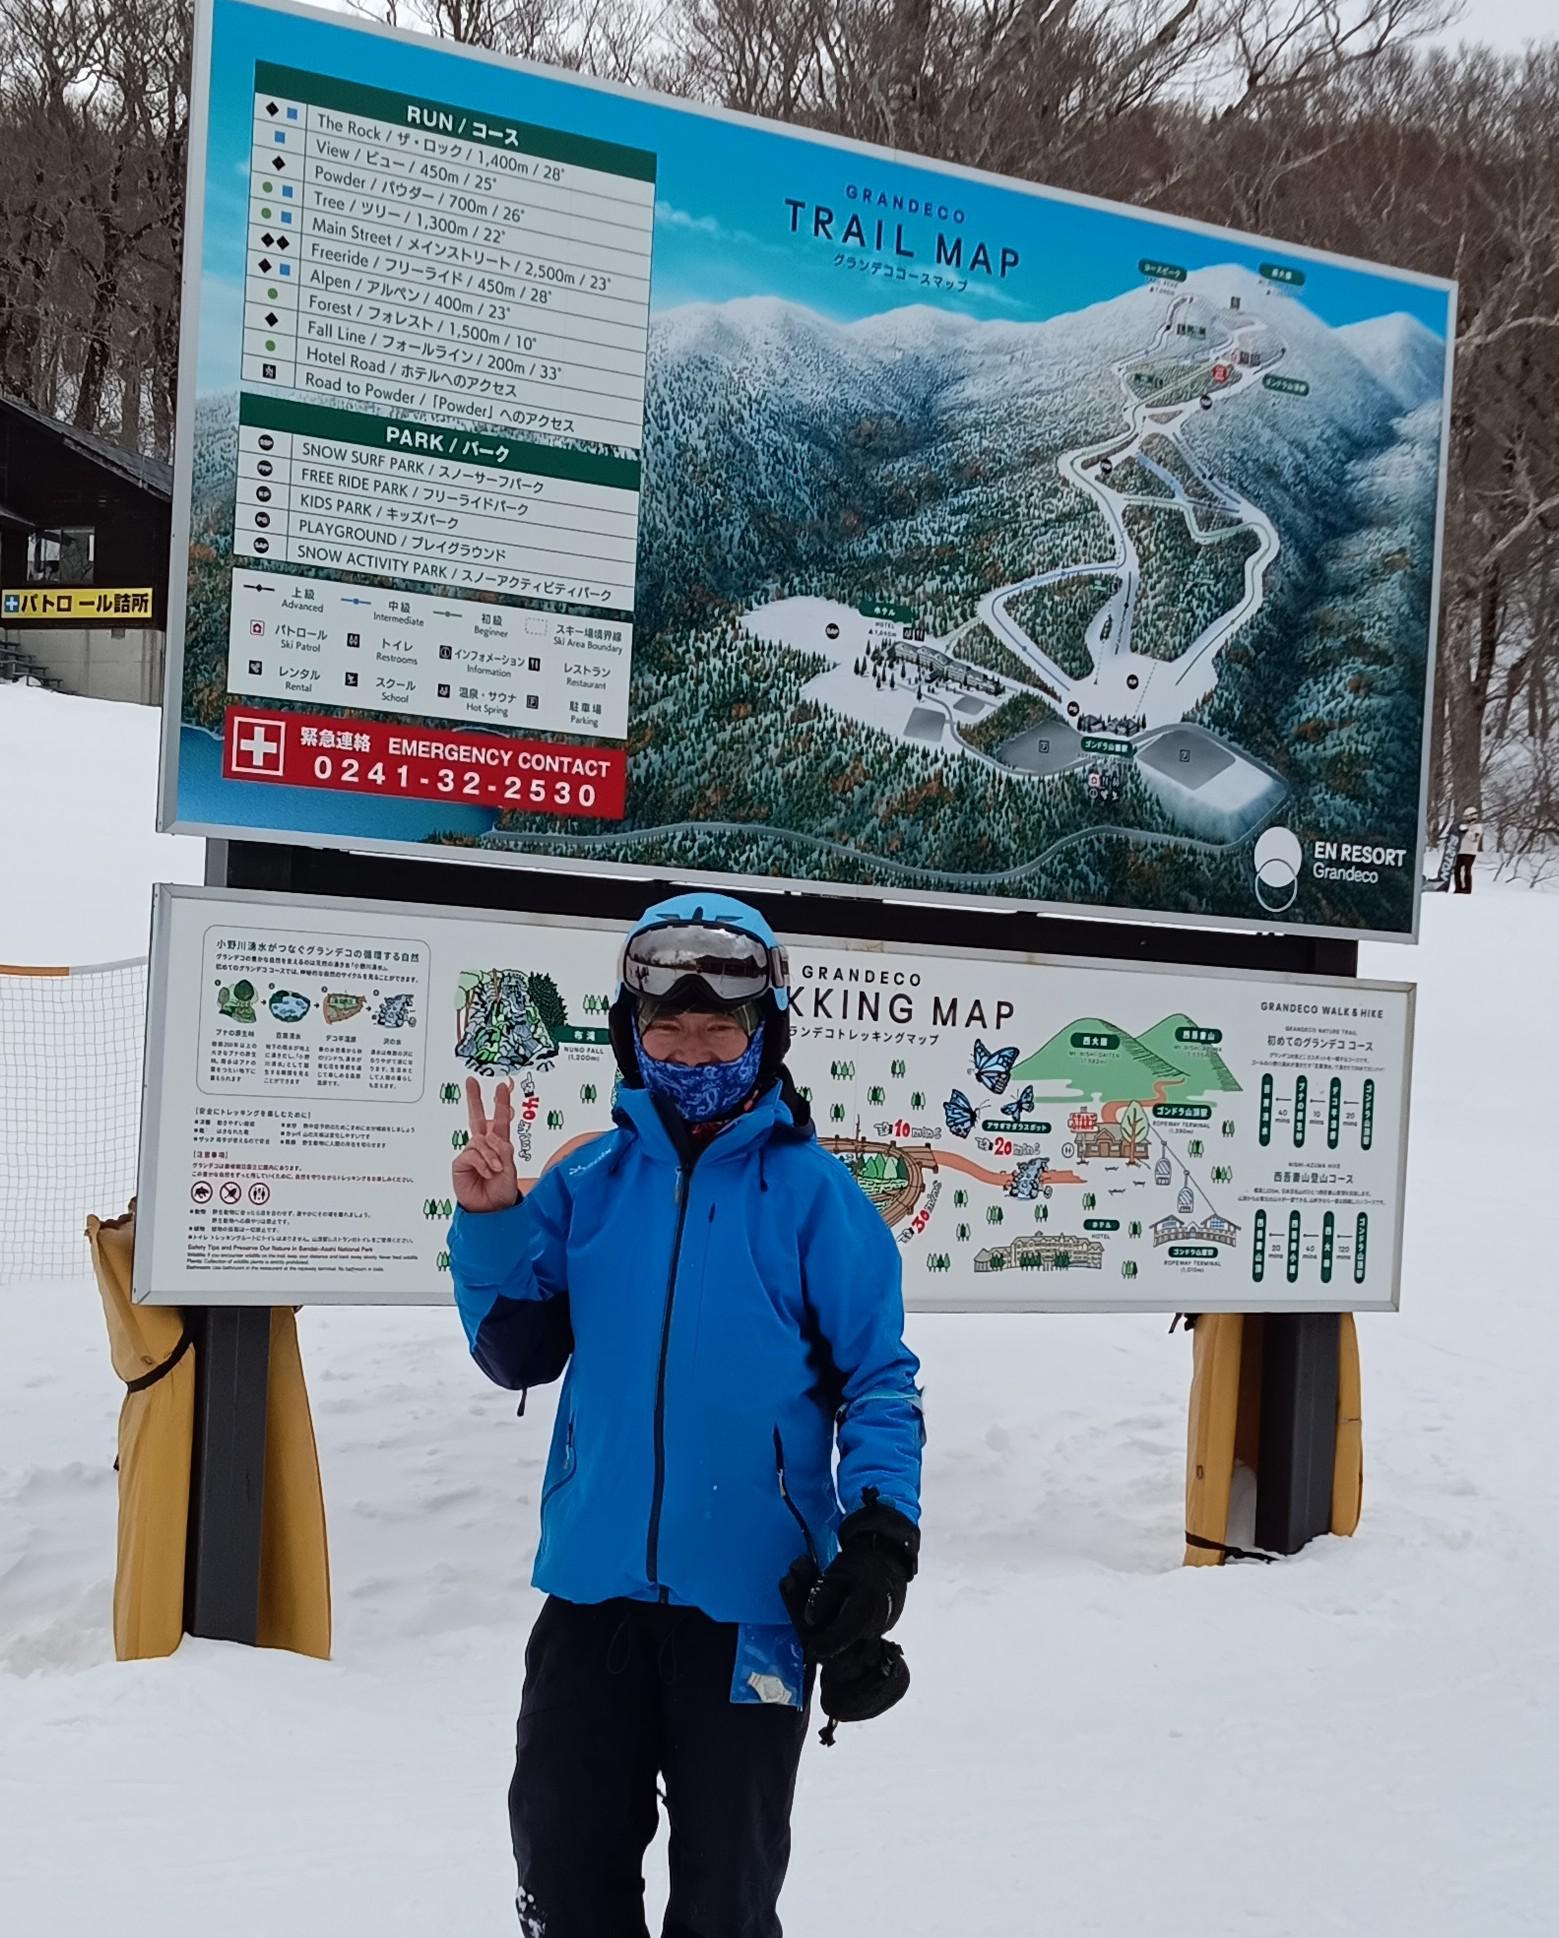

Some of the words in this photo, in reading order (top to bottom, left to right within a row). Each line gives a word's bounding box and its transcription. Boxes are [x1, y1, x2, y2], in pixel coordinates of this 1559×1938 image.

[408, 105, 453, 131] RUN
[316, 113, 344, 132] The
[347, 119, 382, 141] Rock
[479, 150, 529, 175] 1,400m
[316, 139, 350, 160] View
[420, 164, 458, 183] 450m
[314, 165, 366, 189] Powder
[450, 194, 488, 217] 700m
[314, 191, 344, 210] Tree
[418, 213, 467, 236] 1,300m
[846, 184, 965, 224] GRANDECO
[784, 198, 914, 258] TRAIL
[936, 232, 1020, 278] MAP
[312, 217, 346, 236] Main
[351, 225, 390, 245] Street
[525, 262, 574, 285] 2,500m
[312, 243, 368, 267] Freeride
[478, 278, 514, 296] 450m
[834, 252, 968, 292] グランデココースマップ
[310, 269, 351, 293] Alpen
[434, 294, 472, 313] 400m
[309, 294, 350, 315] Forest
[450, 322, 499, 344] 1,500m
[308, 320, 332, 337] Fall
[338, 326, 365, 344] Line
[488, 354, 524, 373] 200m
[307, 346, 344, 365] Hotel
[350, 354, 384, 373] Road
[306, 372, 340, 391] Road
[346, 381, 360, 394] to
[365, 383, 414, 403] Powder
[386, 426, 442, 451] PARK
[302, 442, 346, 460] SNOW
[352, 450, 384, 466] SURF
[390, 457, 423, 474] PARK
[302, 468, 333, 484] FREE
[338, 474, 368, 490] RIDE
[374, 480, 407, 496] PARK
[300, 494, 332, 510] KIDS
[336, 499, 371, 516] PARK
[299, 519, 396, 545] PLAYGROUND
[298, 545, 342, 562] SNOW
[346, 552, 408, 572] ACTIVITY
[413, 562, 446, 578] PARK
[21, 592, 149, 613] パトロール詰所
[282, 600, 324, 613] Advanced
[374, 612, 424, 626] Intermediate
[275, 624, 328, 641] パトロール
[474, 626, 508, 638] Beginner
[280, 640, 294, 650] Ski
[296, 641, 321, 652] Patrol
[382, 638, 414, 652] トイレ
[554, 636, 566, 646] Ski
[567, 638, 586, 649] Area
[588, 642, 622, 656] Boundary
[376, 652, 418, 666] Restrooms
[454, 648, 526, 668] インフォメーション
[279, 666, 321, 681] レンタル
[467, 664, 512, 678] Information
[564, 663, 612, 678] レストラン
[286, 681, 312, 692] Rental
[376, 677, 416, 692] スクール
[566, 677, 607, 690] Restaurant
[382, 692, 409, 704] School
[466, 702, 482, 714] Hot
[484, 704, 508, 718] Spring
[570, 714, 599, 728] Parking
[300, 726, 371, 753] 緊急連絡
[388, 737, 512, 768] EMERGENCY
[518, 752, 611, 779] CONTACT
[1314, 841, 1338, 860] EN
[1340, 843, 1407, 867] RESORT
[1313, 862, 1378, 884] Grandeco
[802, 965, 921, 987] GRANDECO
[932, 996, 1014, 1030] MAP
[1260, 1002, 1318, 1014] GRANDECO
[1322, 1006, 1350, 1017] WALK
[1360, 1008, 1384, 1019] HIKE
[522, 1097, 539, 1120] 40
[894, 1120, 911, 1138] 10
[912, 1126, 942, 1139] mins
[994, 1136, 1012, 1156] 20
[1013, 1142, 1040, 1156] mins
[912, 1210, 930, 1234] 30
